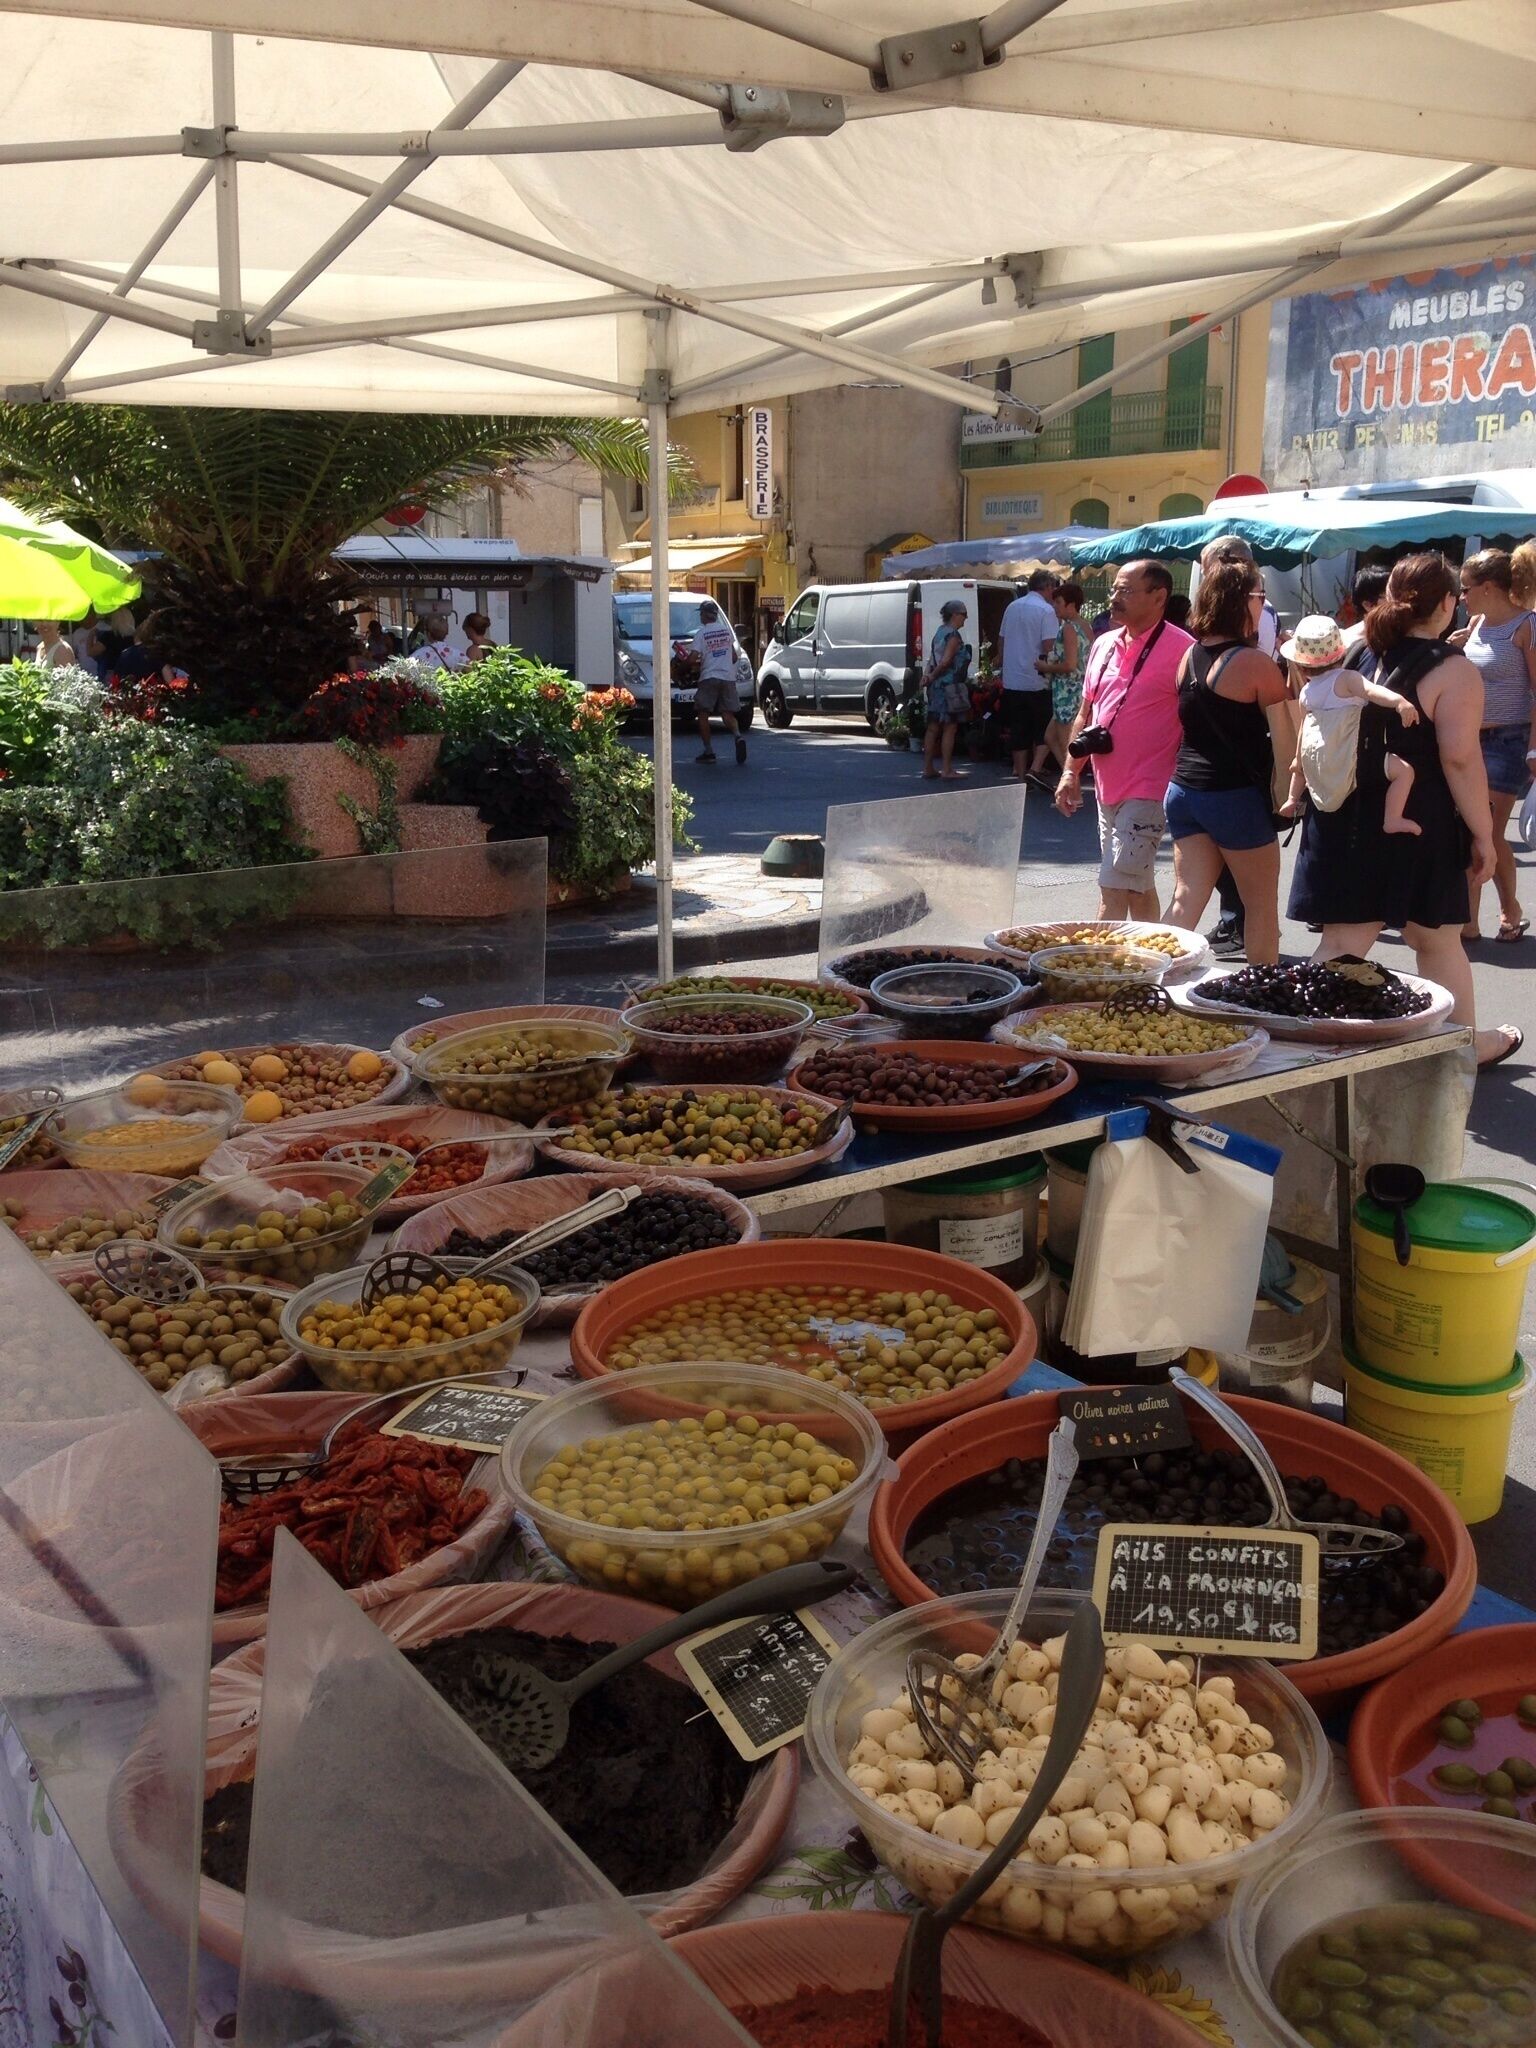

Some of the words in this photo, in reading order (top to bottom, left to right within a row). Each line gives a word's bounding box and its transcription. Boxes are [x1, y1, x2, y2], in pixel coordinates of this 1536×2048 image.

[1389, 281, 1525, 330] MEUBLES
[1330, 323, 1536, 417] THIERA
[755, 412, 769, 515] BRASSERIE
[1073, 1401, 1104, 1419] Olives
[1107, 1403, 1134, 1416] noires
[1137, 1396, 1170, 1412] natures
[1110, 1566, 1128, 1591] À
[1143, 1571, 1172, 1592] LA
